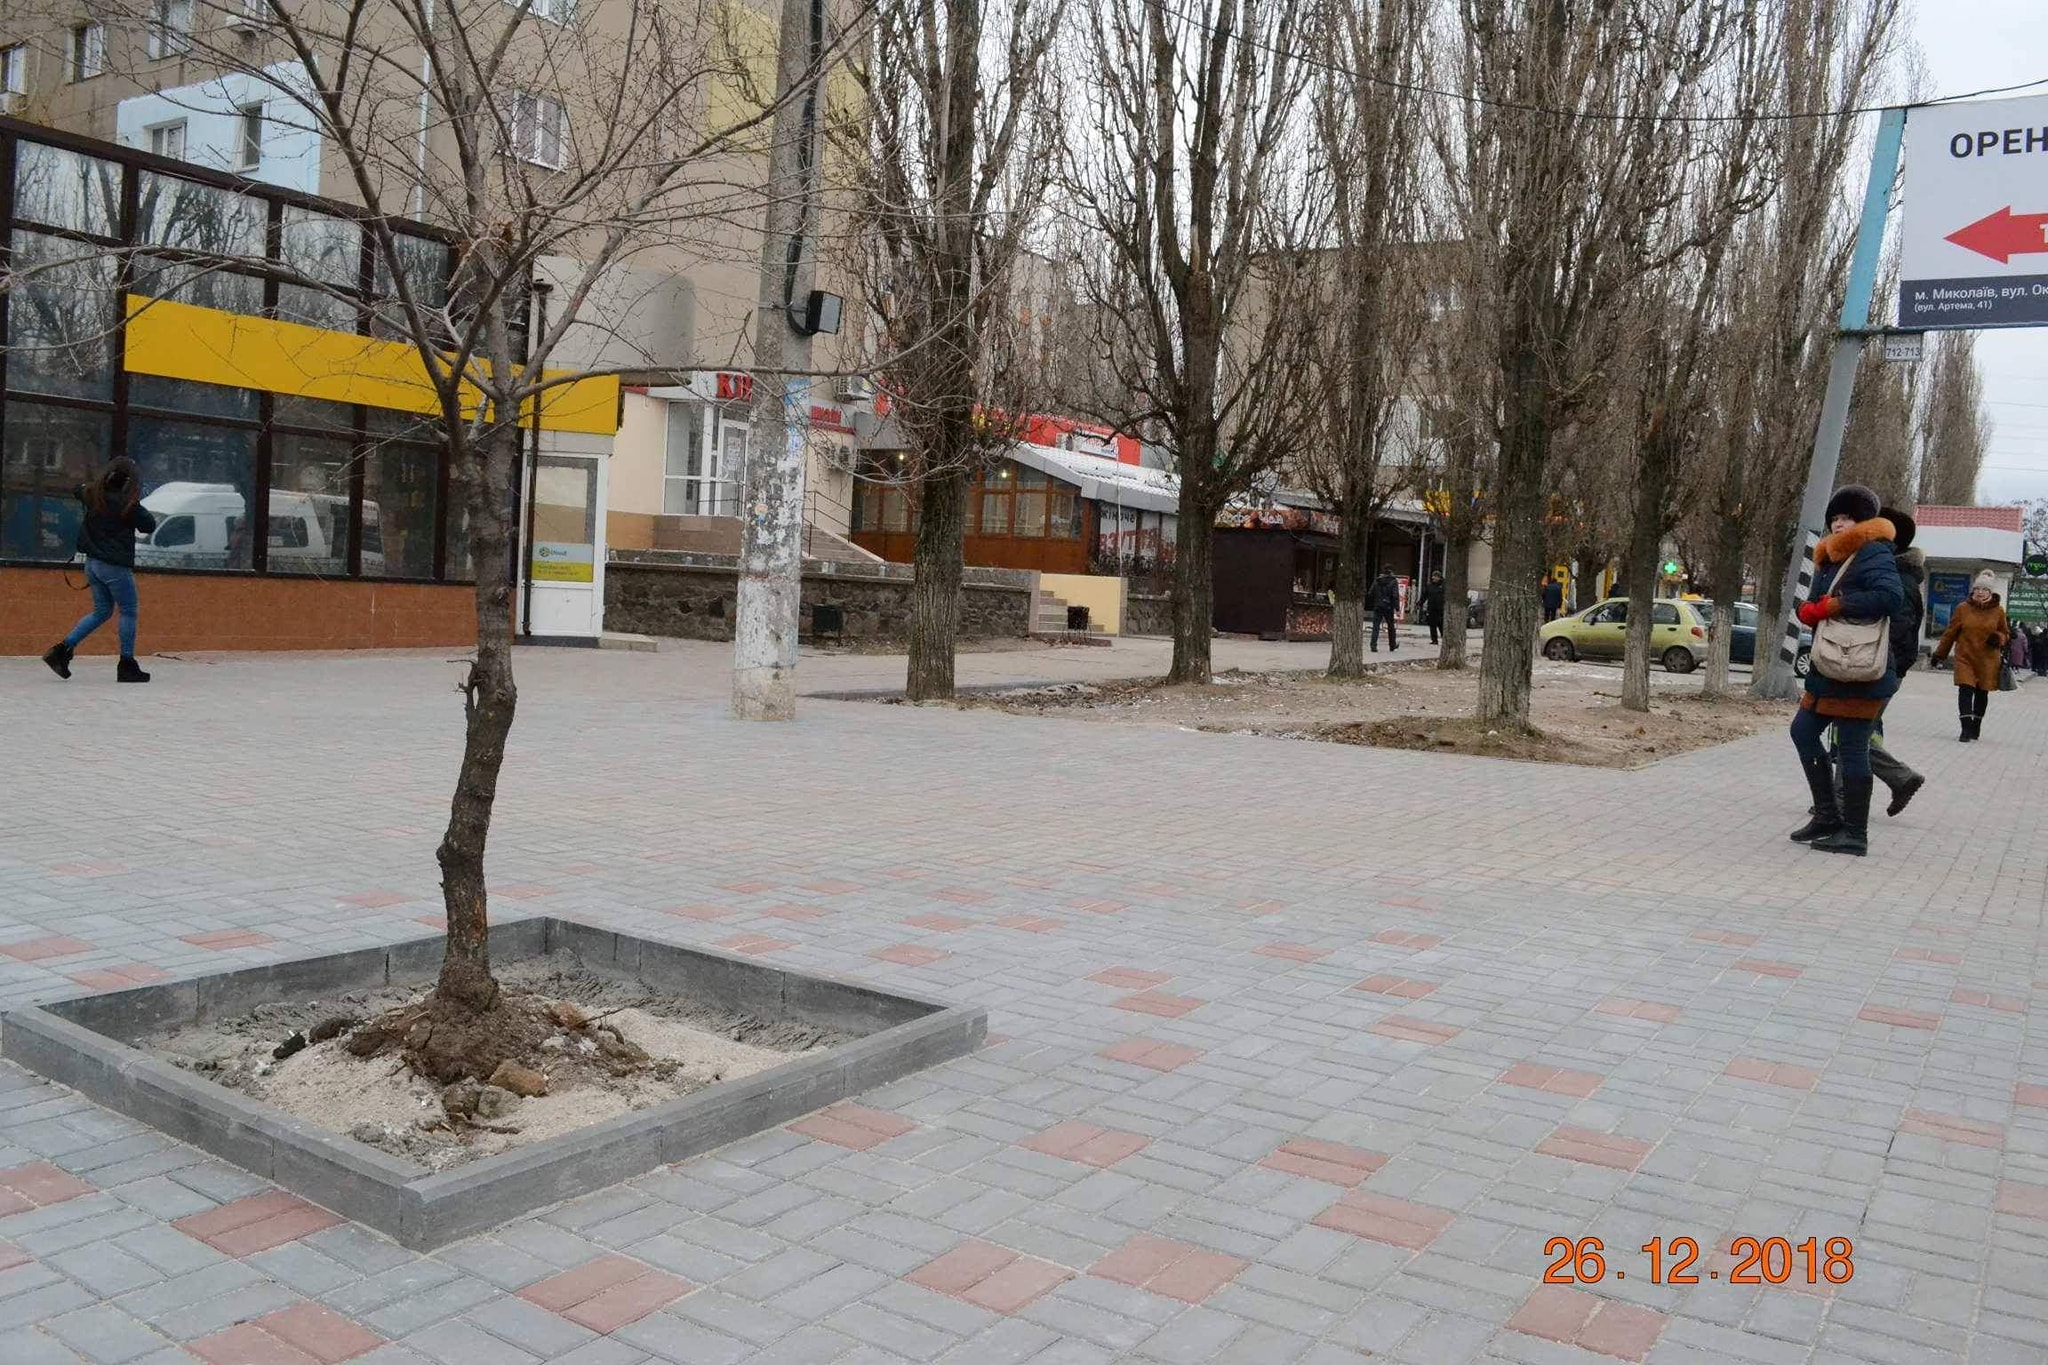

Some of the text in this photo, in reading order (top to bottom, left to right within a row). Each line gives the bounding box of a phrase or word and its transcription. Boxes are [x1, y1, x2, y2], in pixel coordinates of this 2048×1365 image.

[1950, 127, 2048, 158] ОРЕН
[1915, 291, 1928, 300] м.
[1933, 286, 1998, 299] Миколаїв,
[2001, 286, 2028, 299] вул.
[1914, 303, 1936, 313] (вул.
[1938, 301, 1976, 312] Артема,
